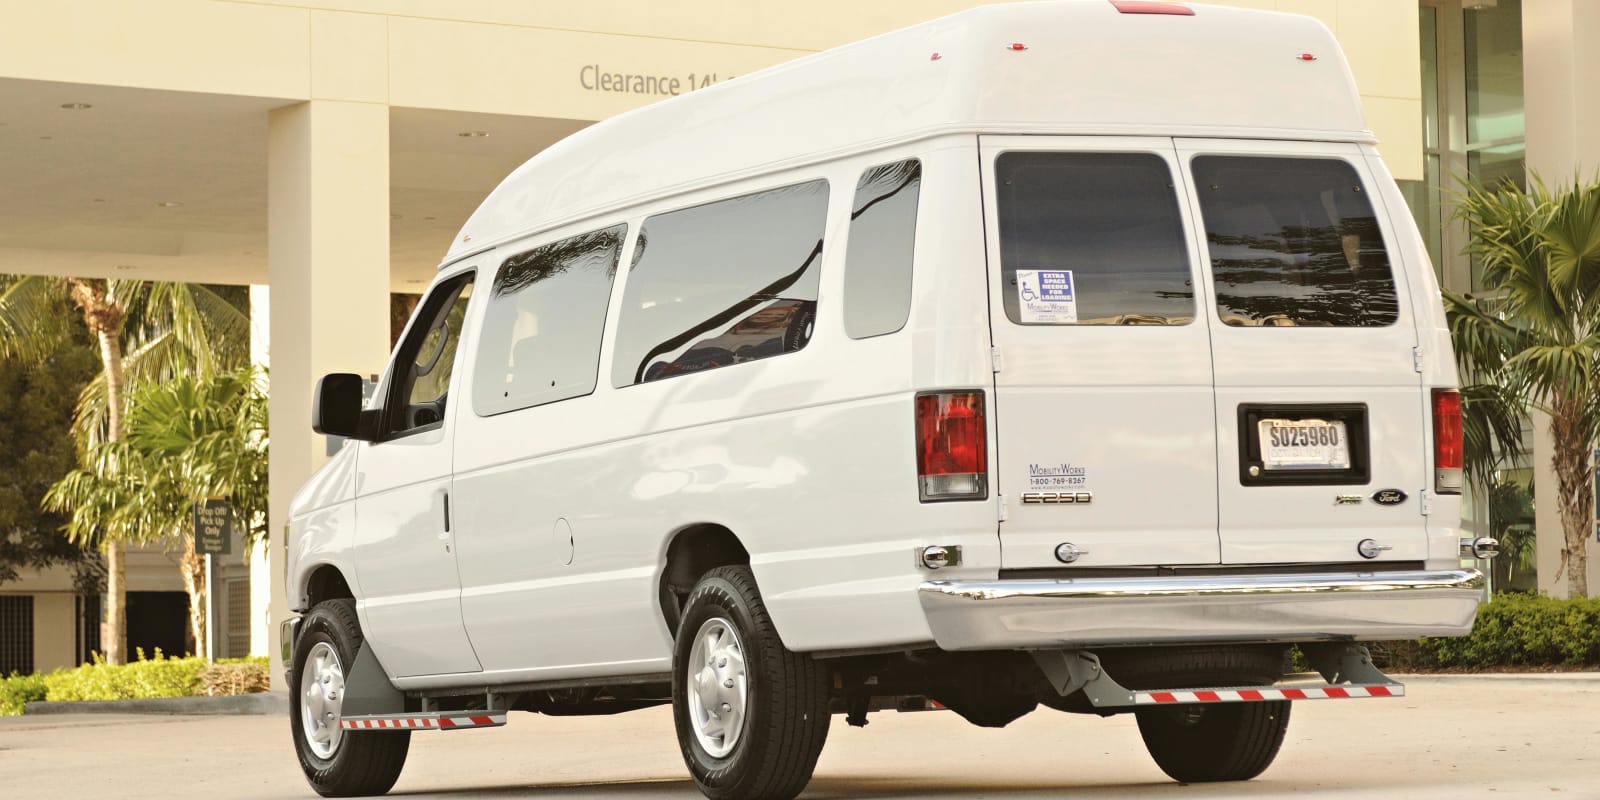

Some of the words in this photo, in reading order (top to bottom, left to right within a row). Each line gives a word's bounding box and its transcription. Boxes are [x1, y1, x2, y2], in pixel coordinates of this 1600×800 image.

[579, 64, 681, 96] Clearance
[1270, 426, 1339, 447] S025980
[1379, 491, 1401, 502] Ford
[200, 516, 213, 525] Pick
[214, 517, 225, 527] Up
[204, 526, 220, 537] Only
